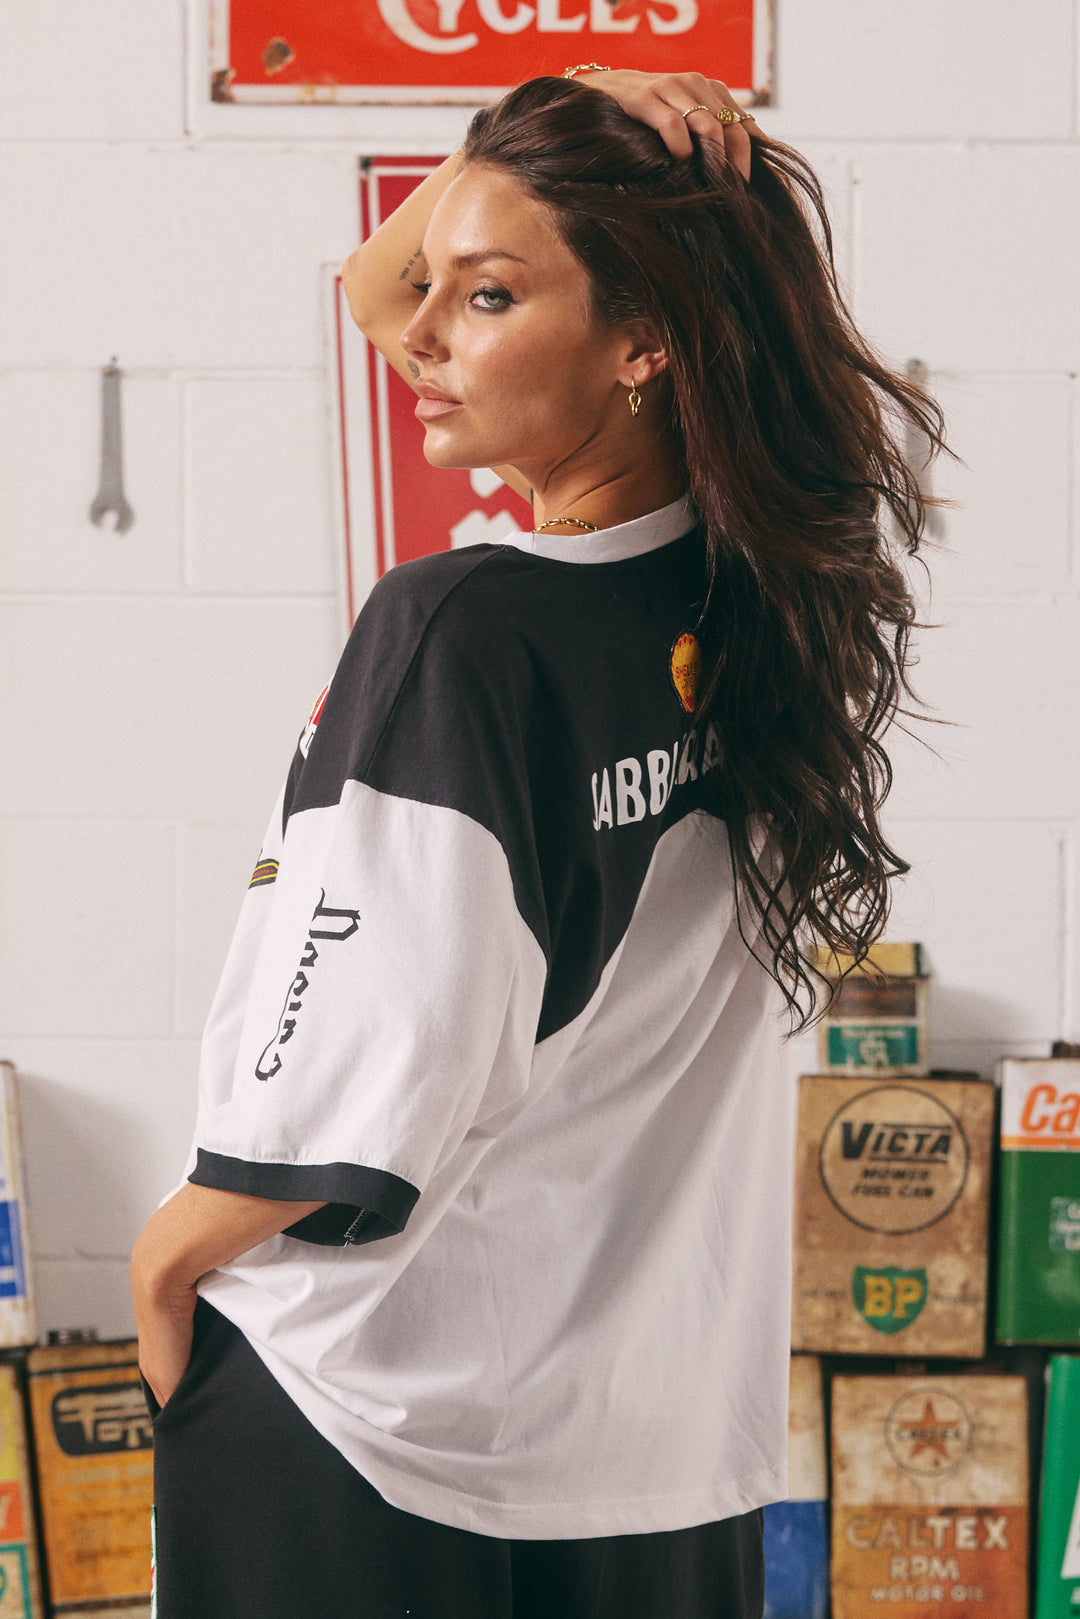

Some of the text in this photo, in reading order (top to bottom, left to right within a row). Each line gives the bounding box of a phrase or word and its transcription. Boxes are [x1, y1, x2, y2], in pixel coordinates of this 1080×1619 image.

[842, 1122, 951, 1158] VICTA
[863, 1275, 923, 1318] BP
[845, 1514, 1008, 1550] CALTEX
[889, 1555, 960, 1582] RPM
